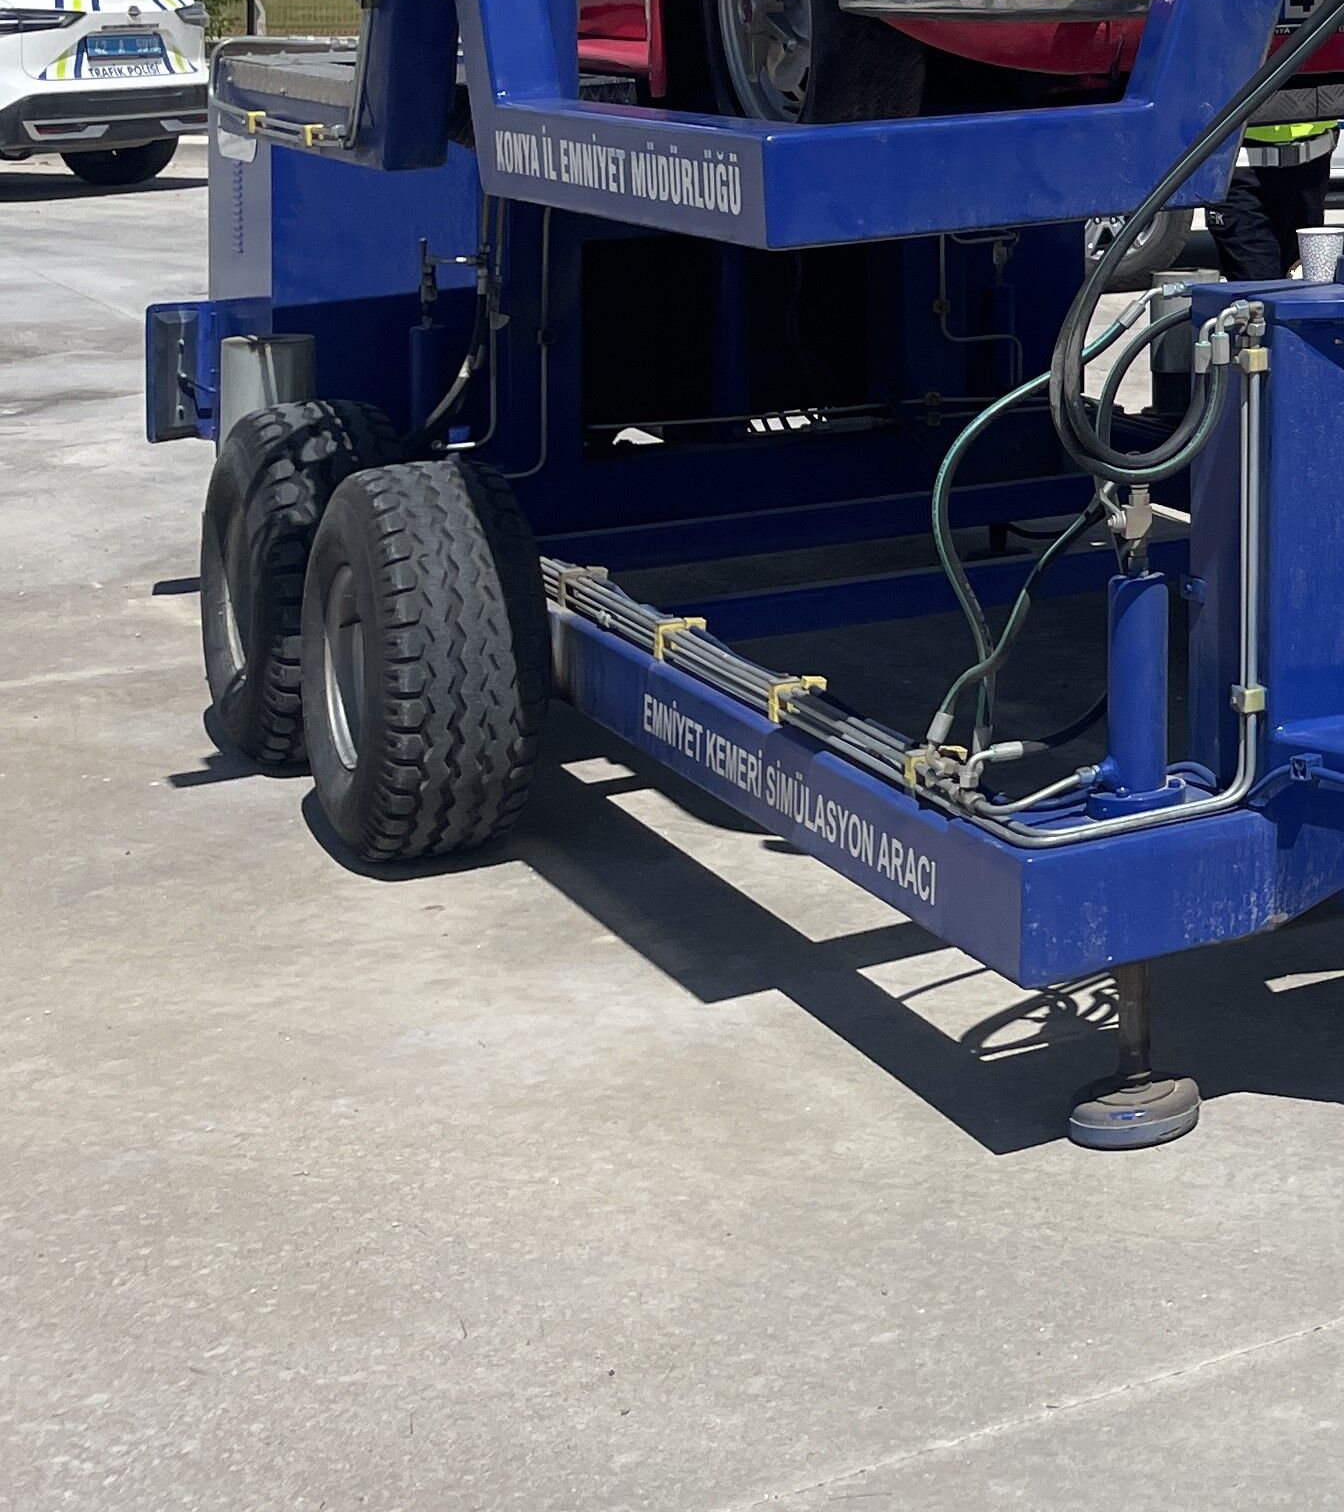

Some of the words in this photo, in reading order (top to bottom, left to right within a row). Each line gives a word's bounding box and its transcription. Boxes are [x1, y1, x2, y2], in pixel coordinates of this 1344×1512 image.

[495, 129, 540, 178] KONYA
[541, 125, 558, 181] İL
[559, 133, 626, 194] EMNİYET
[631, 140, 742, 216] MÜDÜRLÜĞÜ
[643, 692, 703, 762] EMNİYET
[705, 728, 763, 799] KEMERİ
[765, 759, 875, 868] SİMÜLASYON
[877, 832, 937, 906] ARACI
